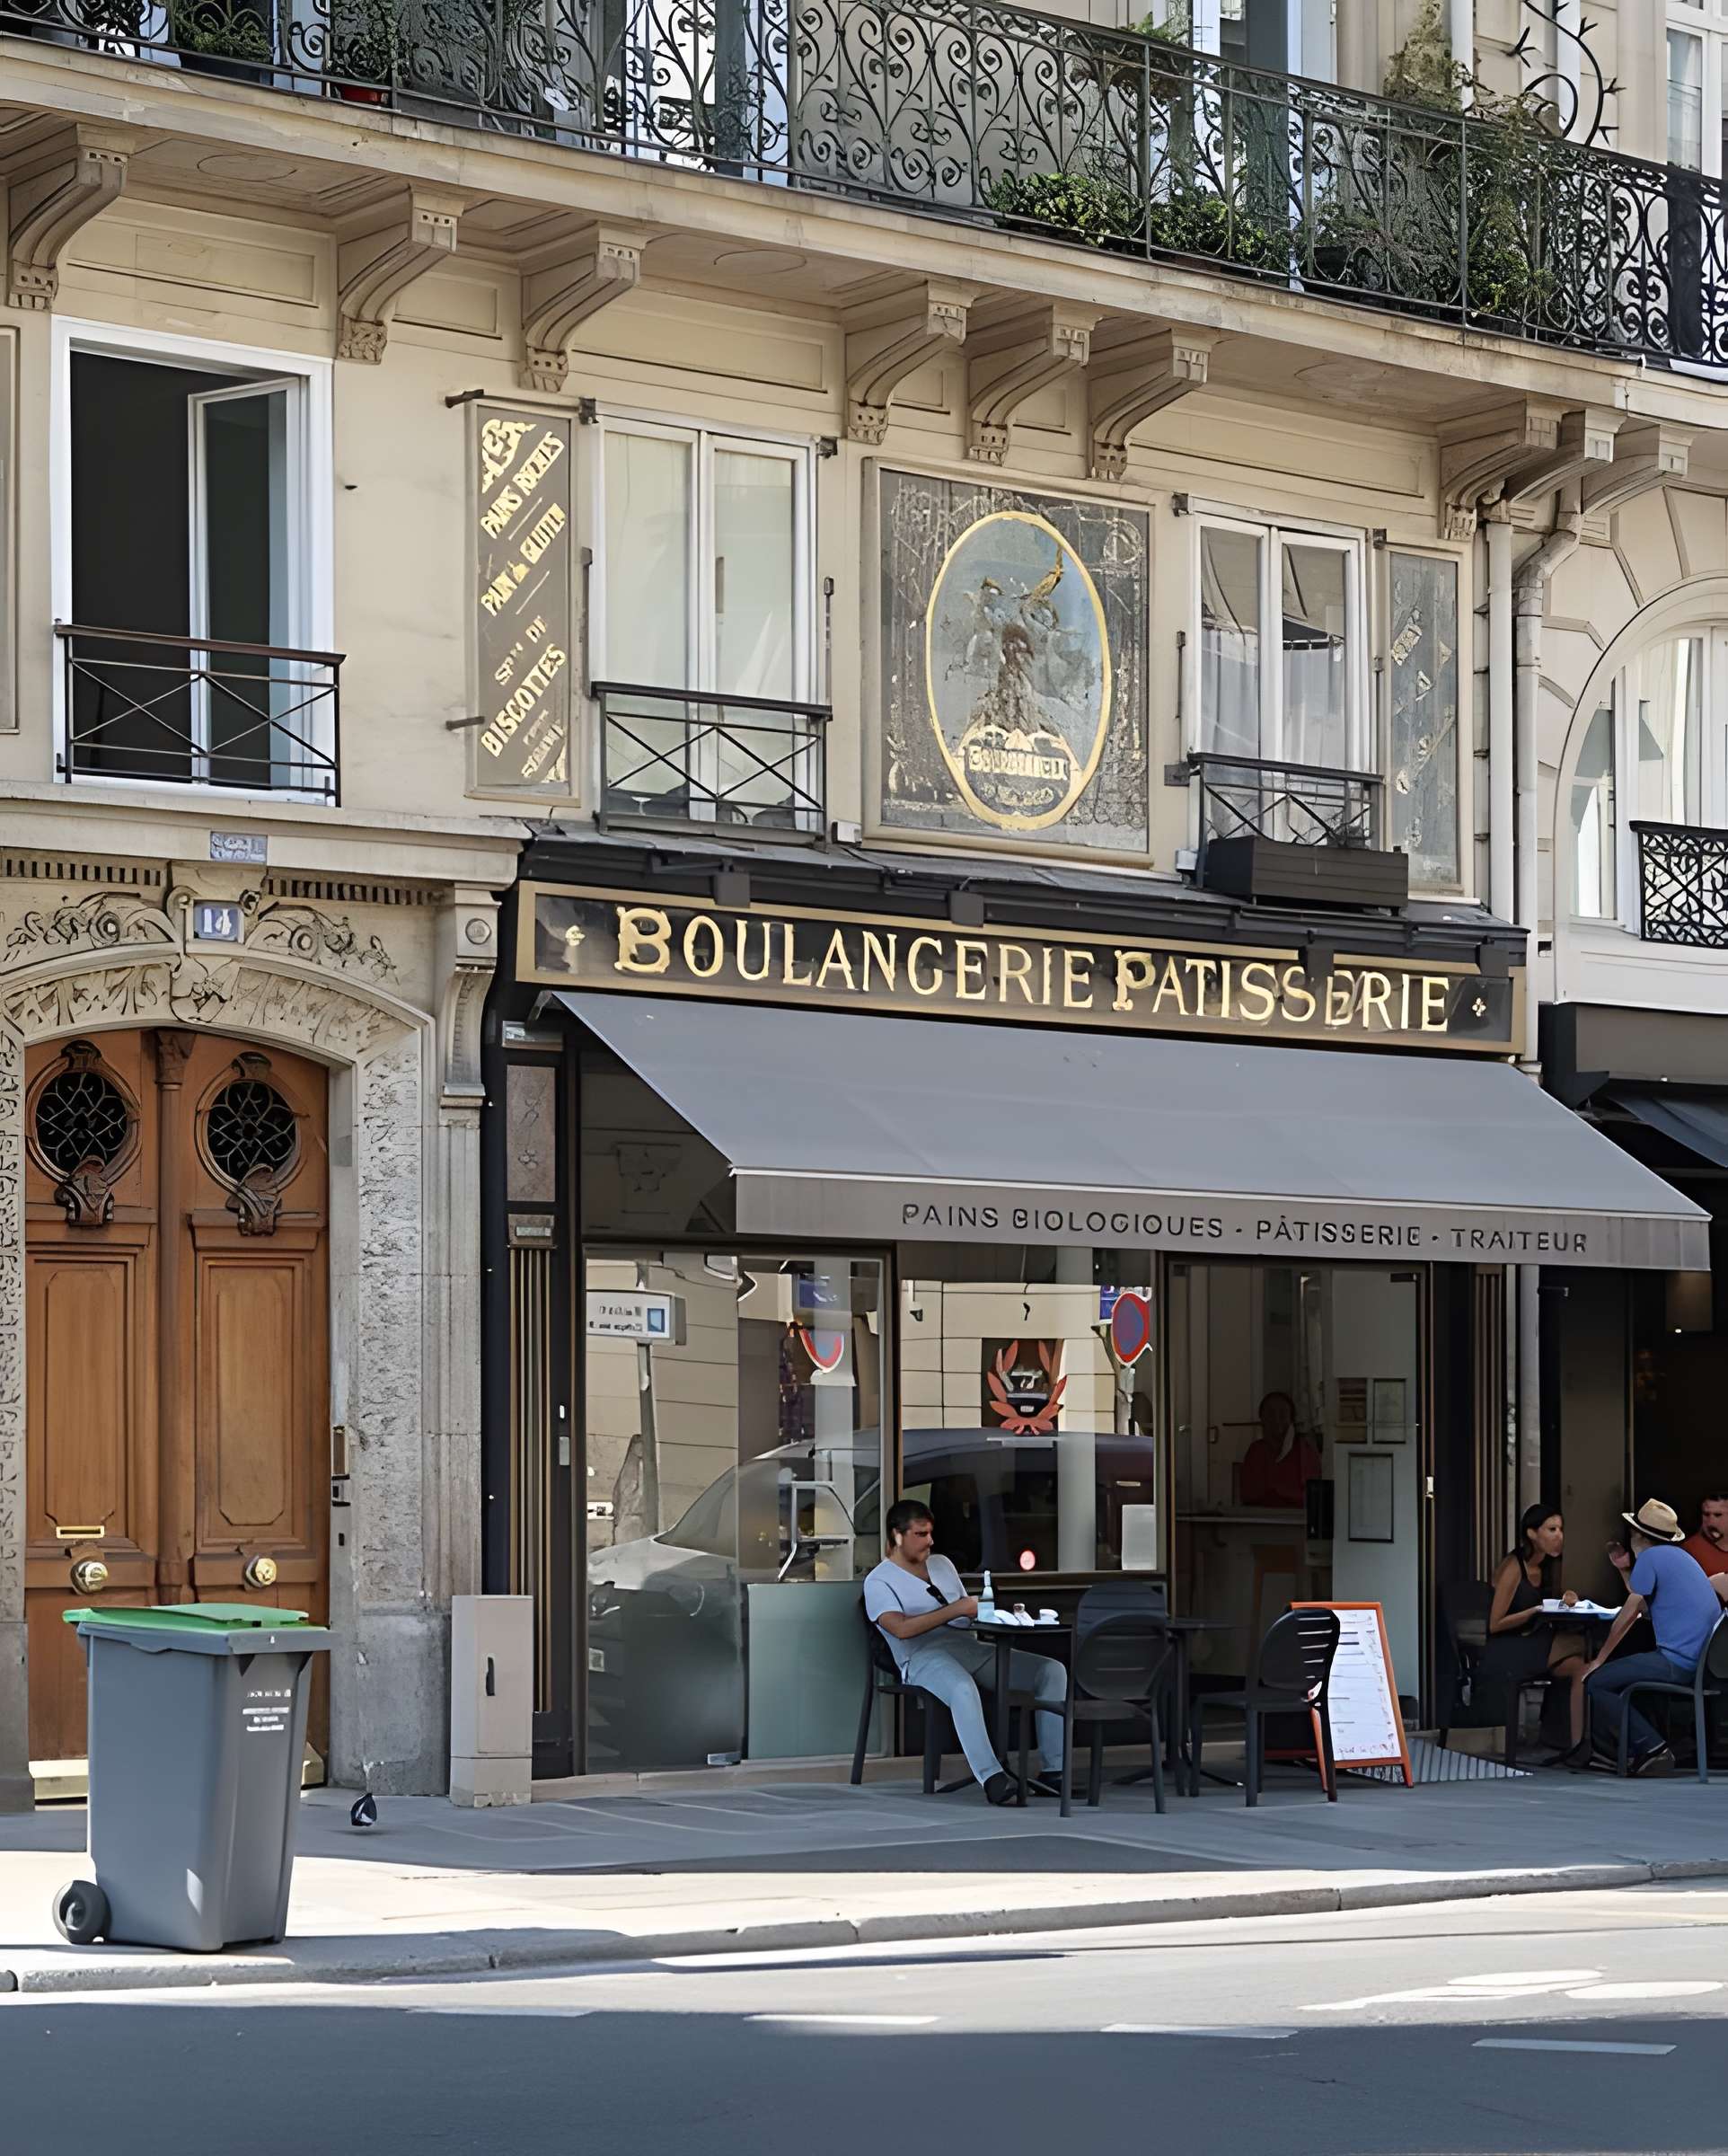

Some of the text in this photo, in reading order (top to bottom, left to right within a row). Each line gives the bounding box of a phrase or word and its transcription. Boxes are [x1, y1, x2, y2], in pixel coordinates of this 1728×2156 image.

[480, 643, 567, 758] BISCOTTES
[613, 904, 1450, 1032] BOULANGERIE PATISSERIE
[902, 1203, 999, 1229] PAINS
[1450, 1227, 1587, 1253] TRAITEUR
